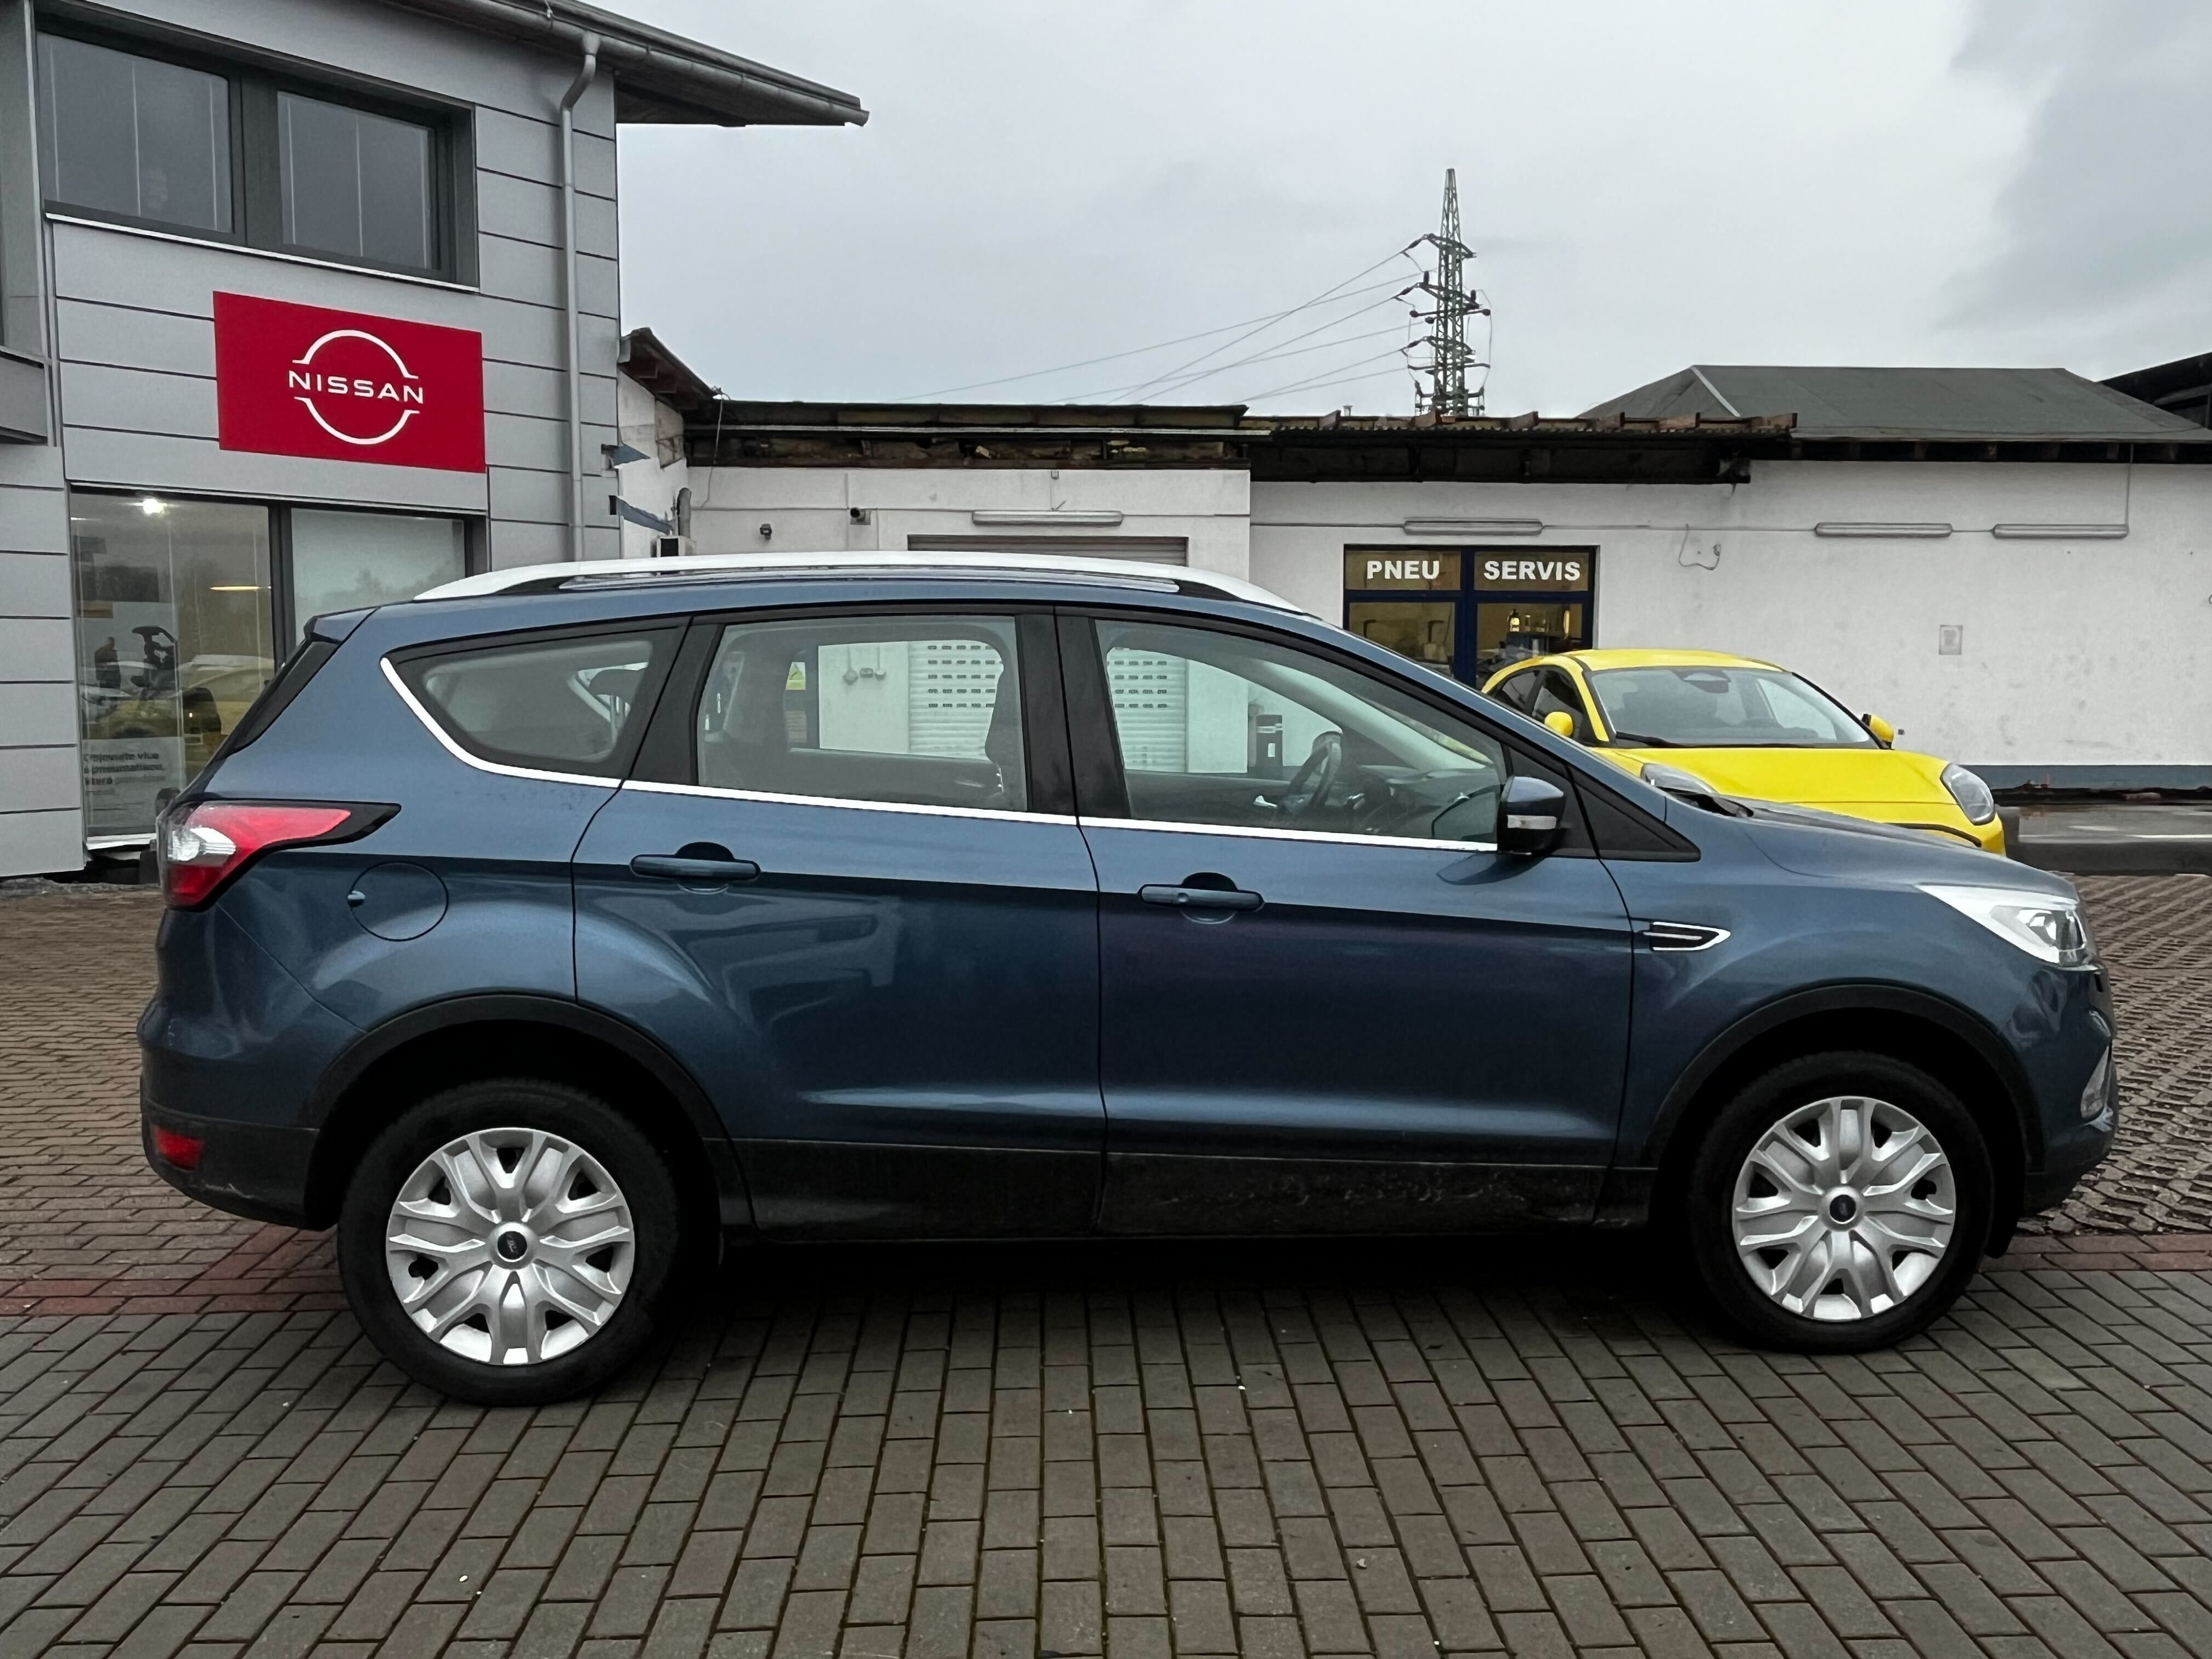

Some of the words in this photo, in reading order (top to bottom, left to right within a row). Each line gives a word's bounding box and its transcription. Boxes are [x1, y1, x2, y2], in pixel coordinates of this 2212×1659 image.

[289, 370, 424, 404] NISSAN
[1367, 560, 1440, 579] PNEU
[1483, 561, 1581, 581] SERVIS
